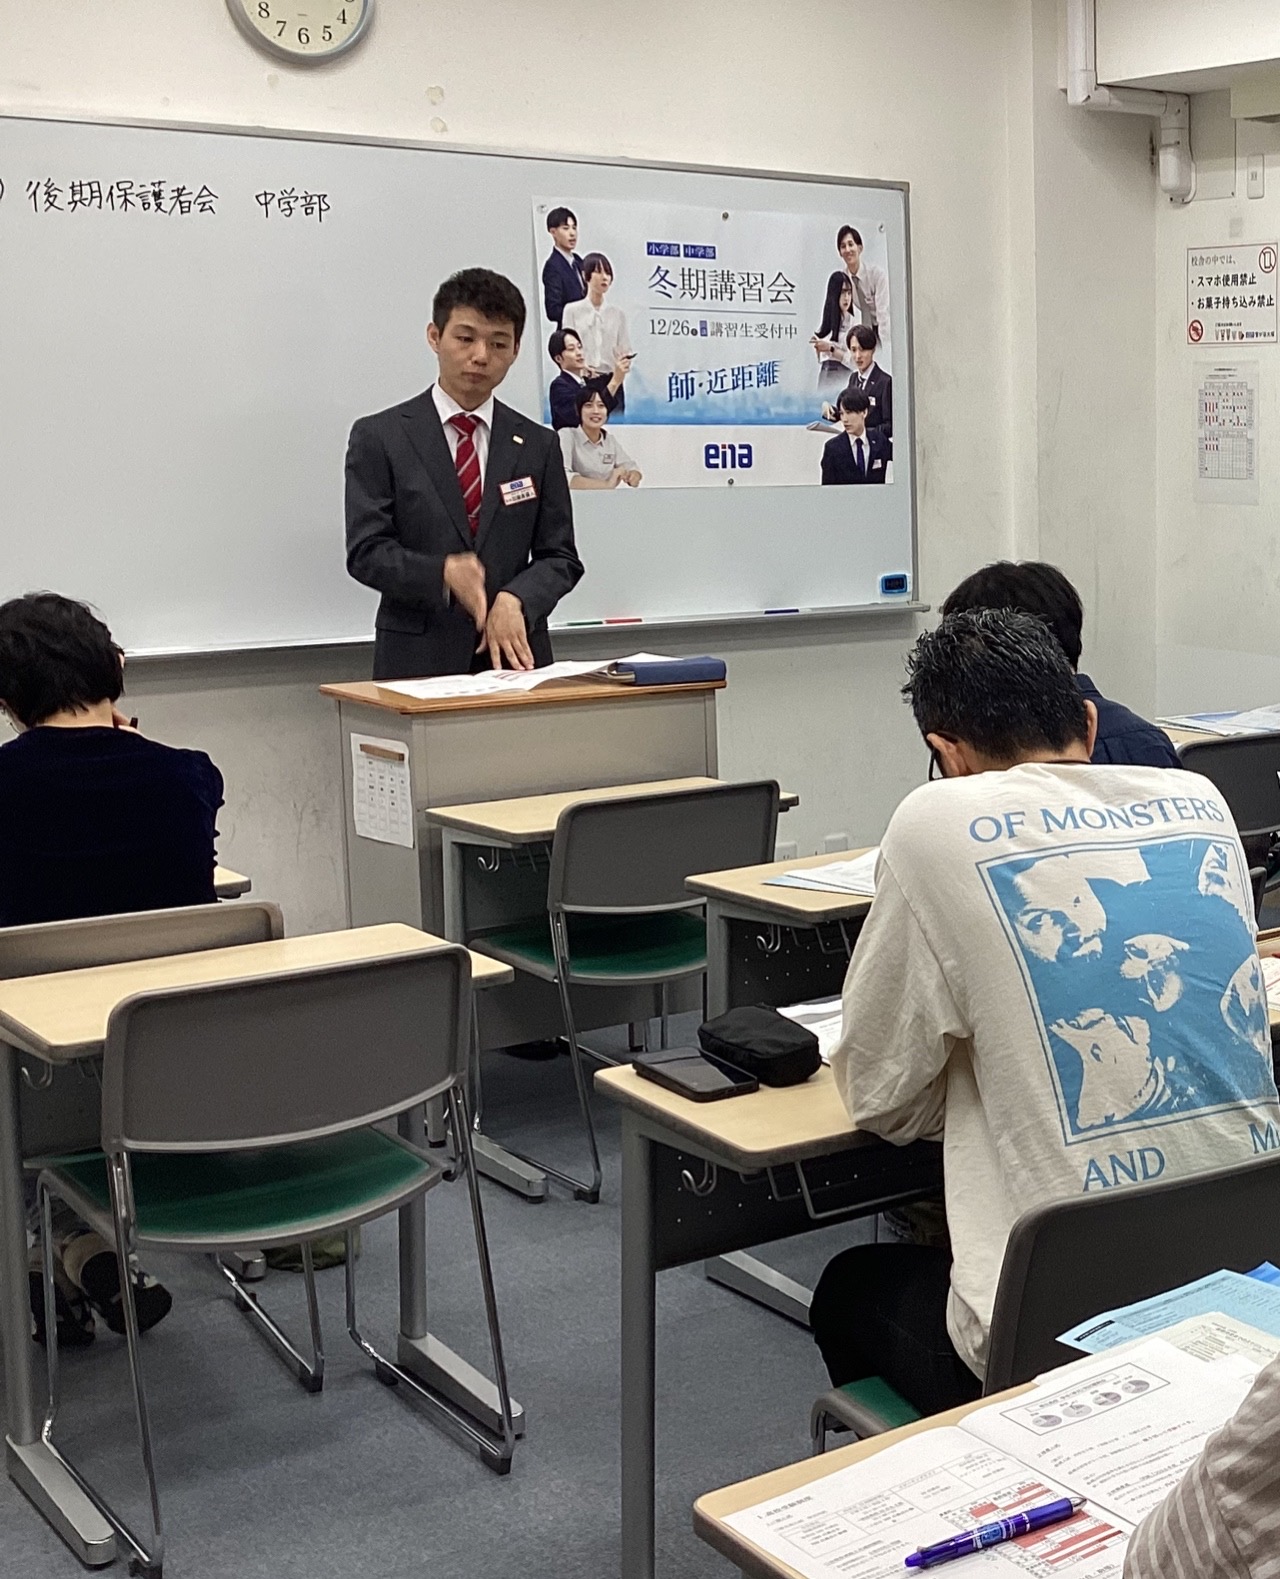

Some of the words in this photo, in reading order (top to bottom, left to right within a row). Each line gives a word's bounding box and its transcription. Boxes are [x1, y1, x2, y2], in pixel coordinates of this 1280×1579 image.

[258, 1, 270, 19] 8
[336, 8, 347, 24] 4
[275, 20, 287, 37] 7
[297, 27, 310, 44] 6
[321, 25, 332, 41] 5
[25, 177, 219, 216] 後期保護者会
[255, 186, 331, 222] 中学部
[648, 264, 796, 304] 冬期講習会
[650, 318, 691, 337] 12/26
[710, 320, 798, 340] 講習生受付中
[969, 811, 1026, 843] OF
[1041, 797, 1226, 834] MONSTERS
[1082, 1147, 1166, 1193] AND
